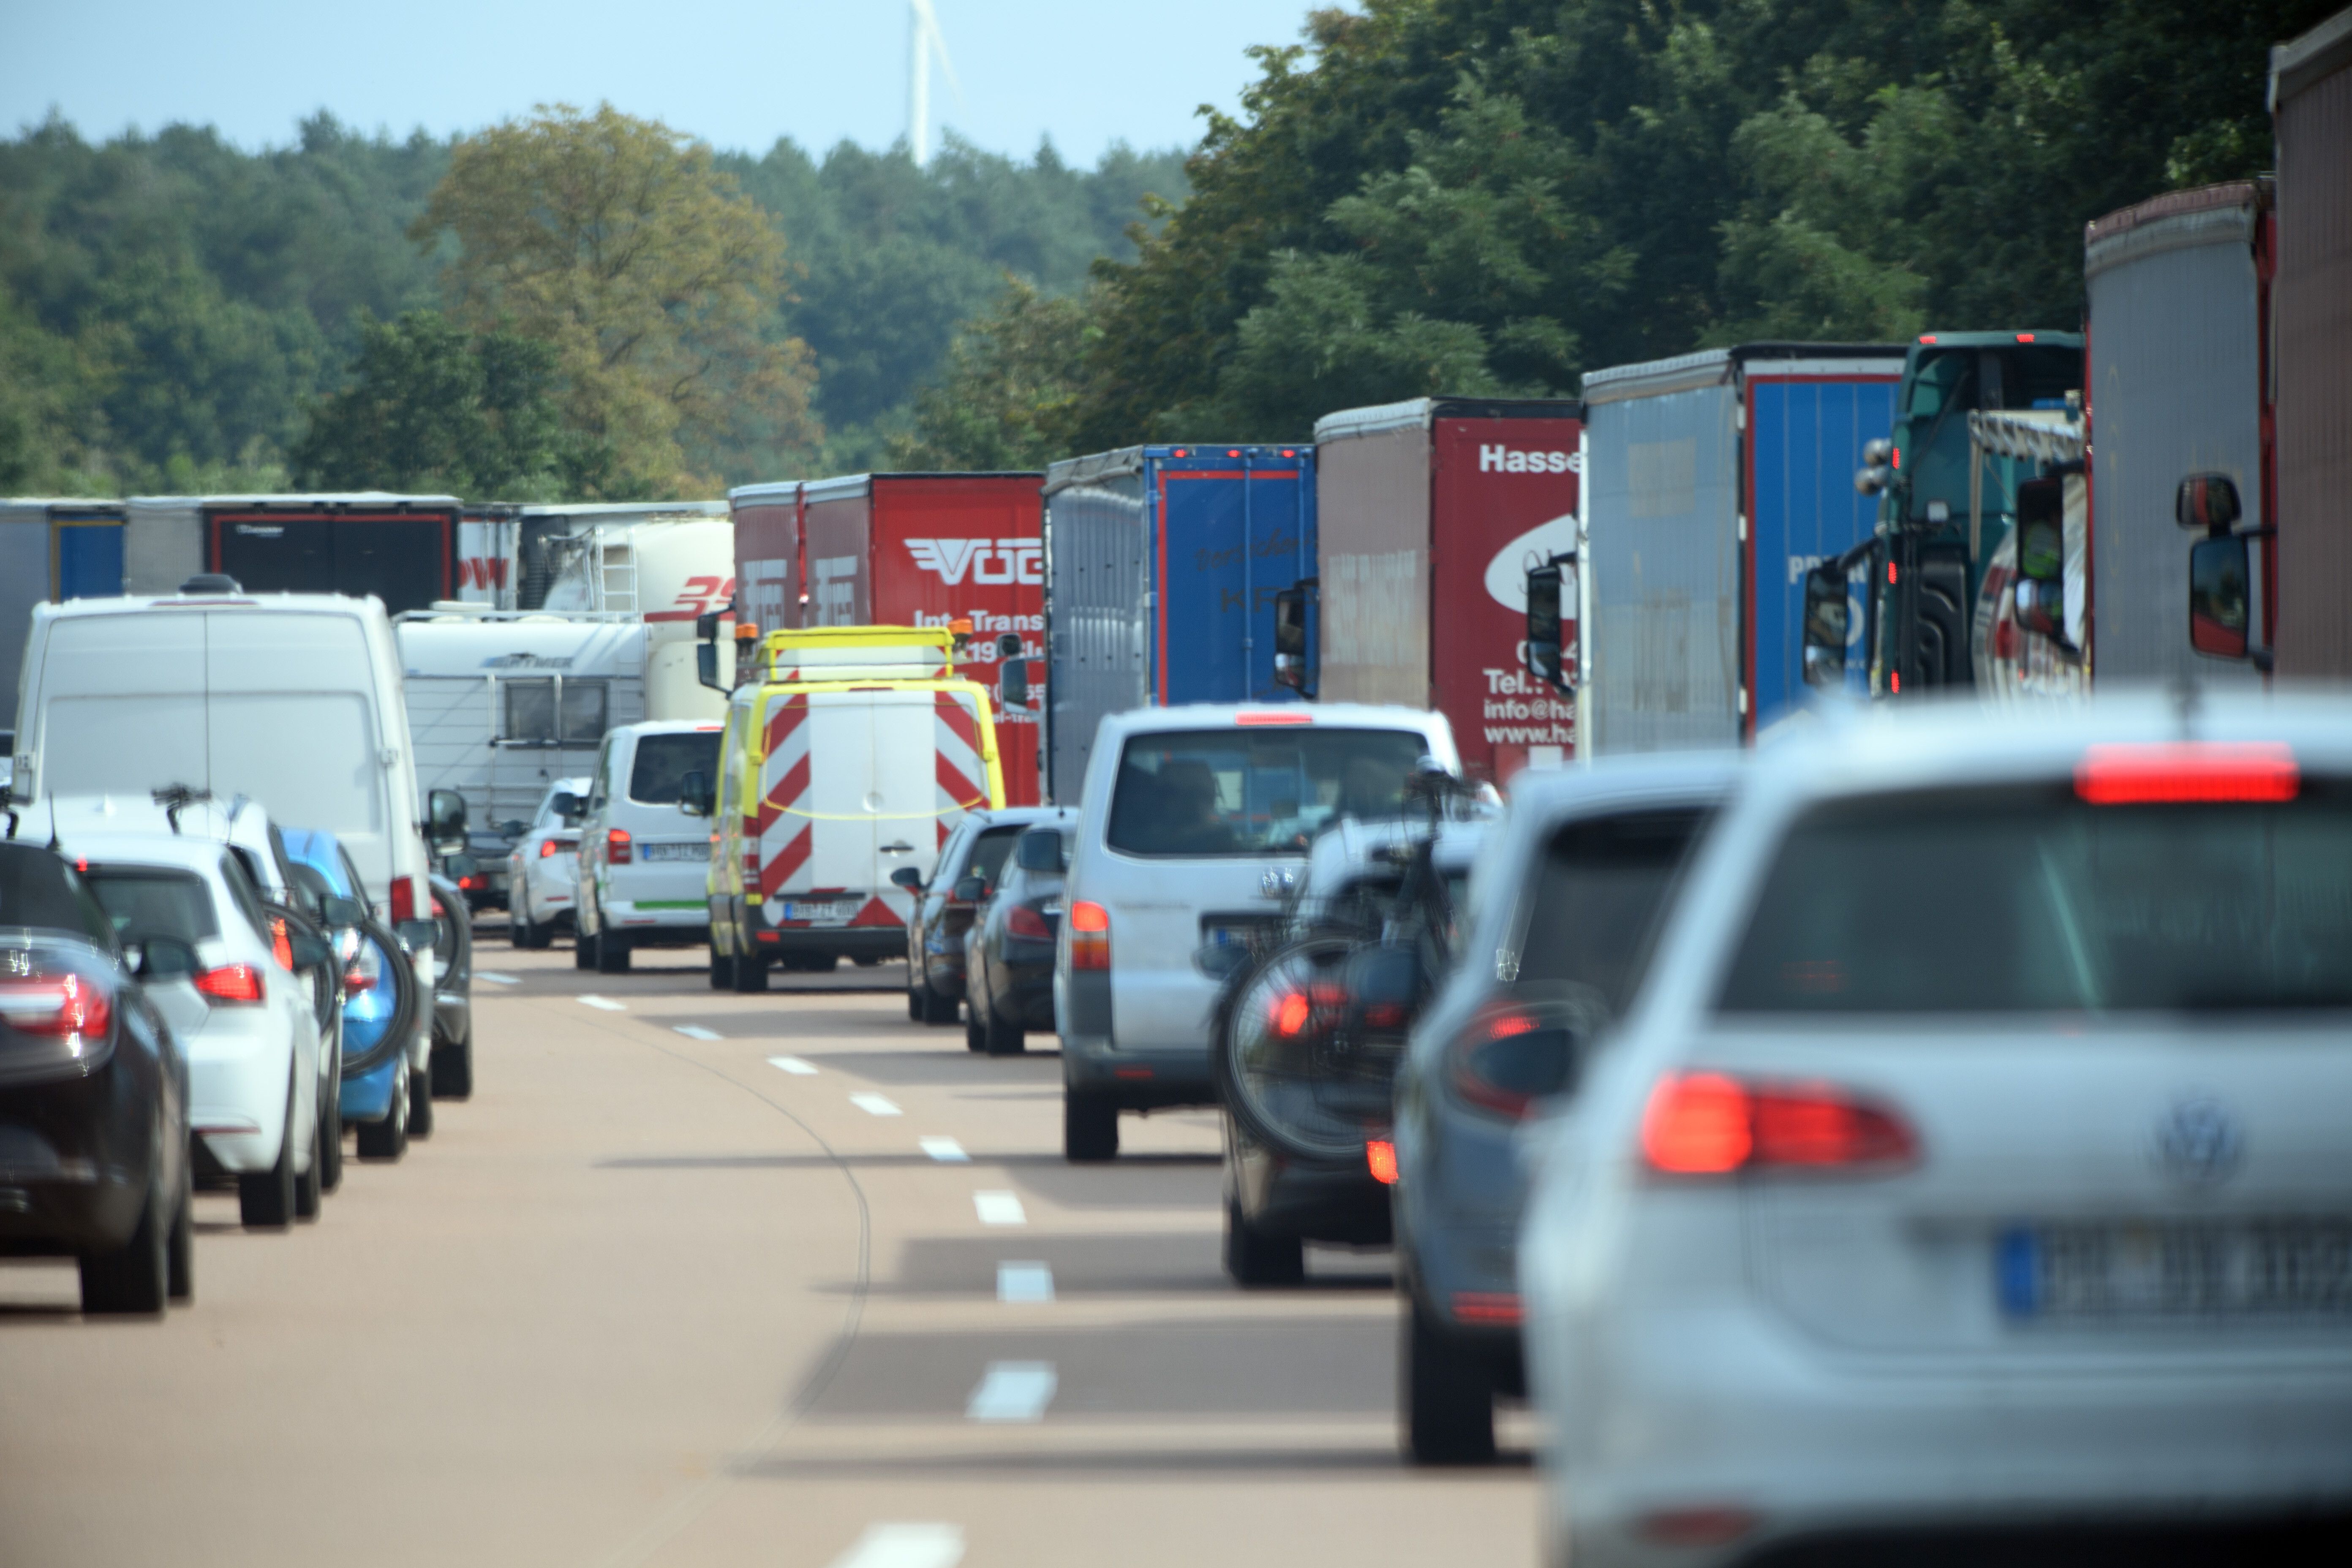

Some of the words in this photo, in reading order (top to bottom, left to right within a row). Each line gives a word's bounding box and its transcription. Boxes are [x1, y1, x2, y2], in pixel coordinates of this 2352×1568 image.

[1480, 444, 1580, 473] Hasse
[968, 610, 1044, 632] Trans
[1482, 668, 1544, 694] Tel.:
